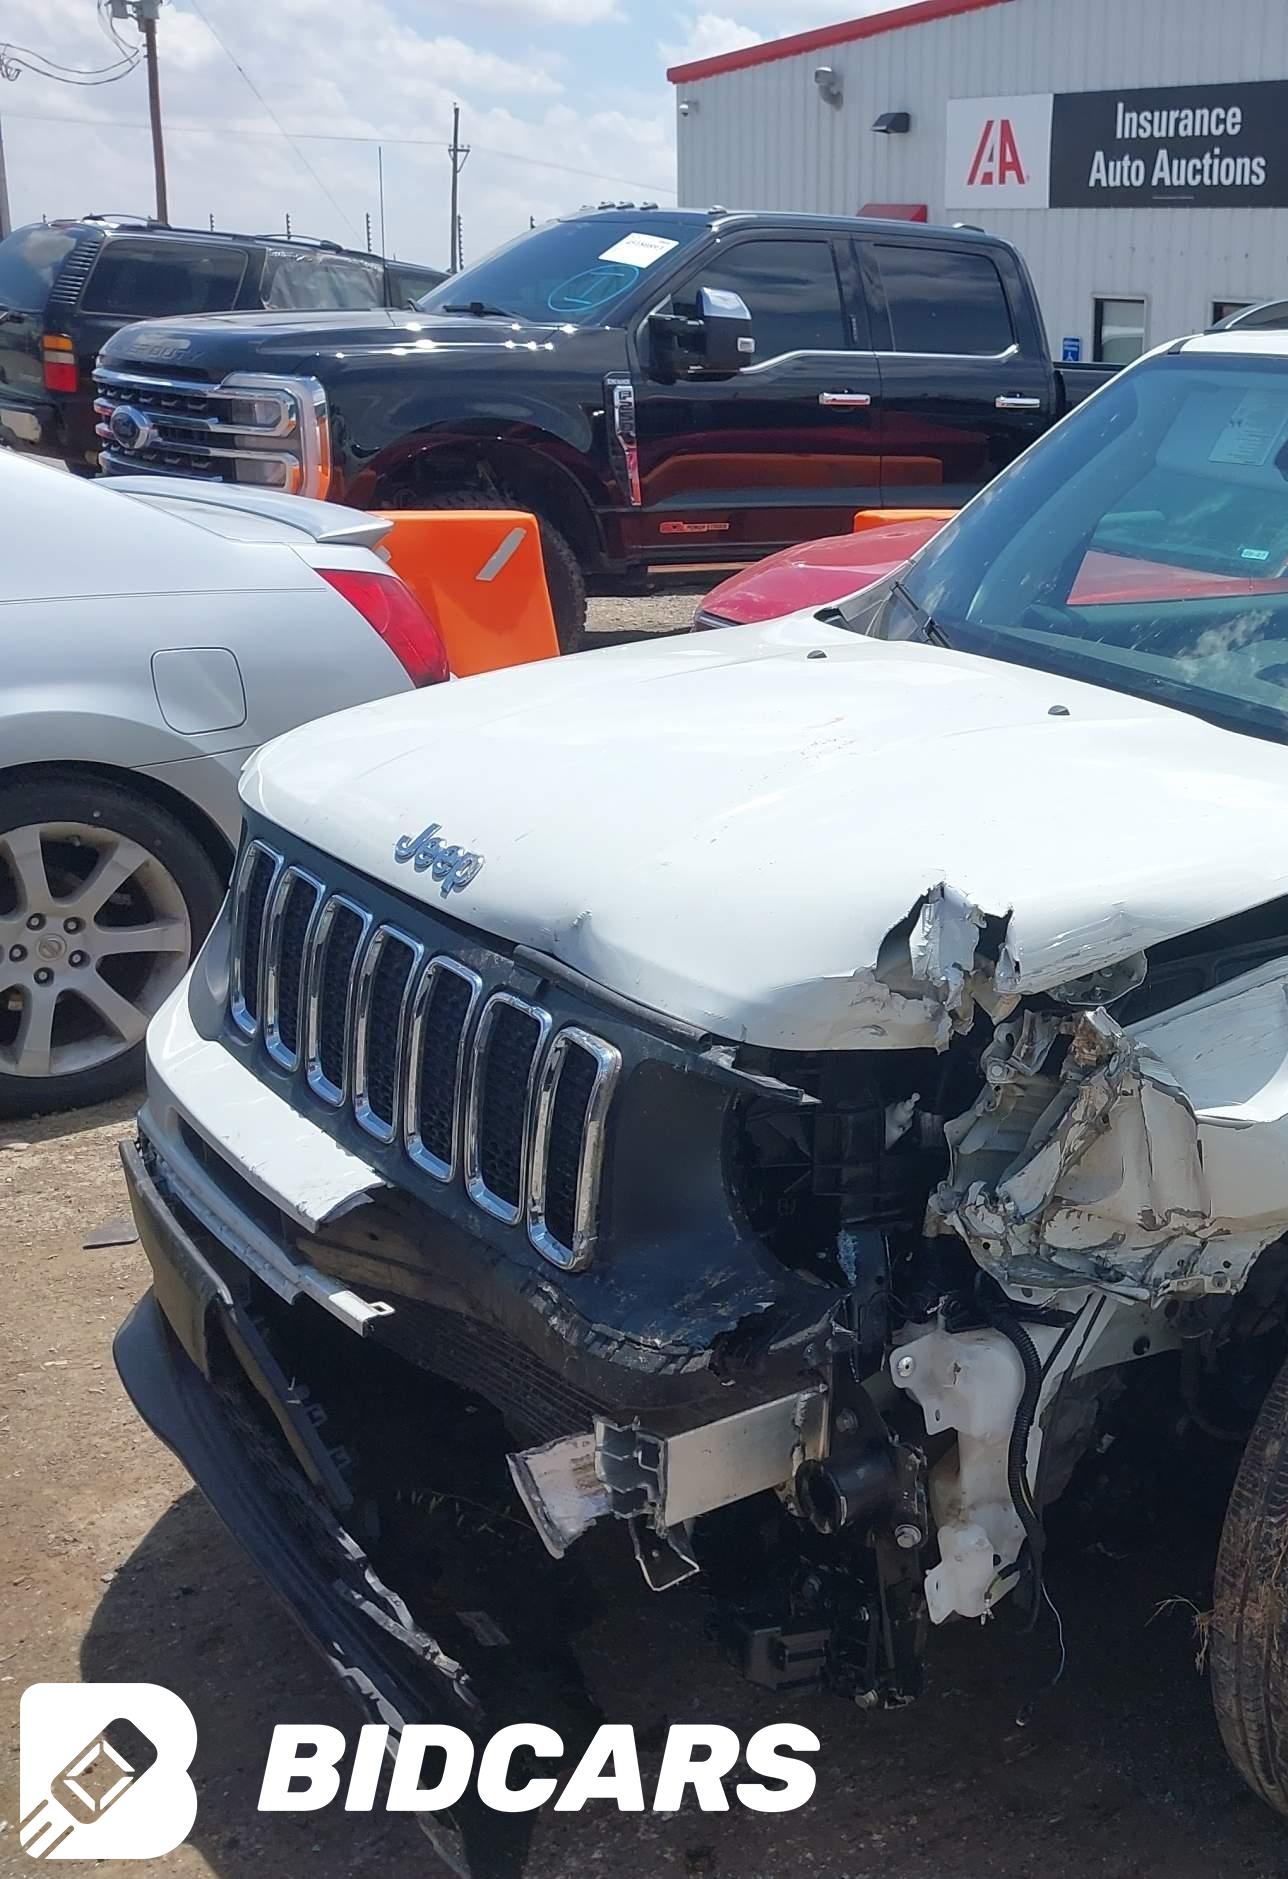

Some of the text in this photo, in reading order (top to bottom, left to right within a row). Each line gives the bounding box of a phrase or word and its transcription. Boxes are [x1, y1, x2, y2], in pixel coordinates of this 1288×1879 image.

[1115, 101, 1243, 139] Insurance
[1088, 147, 1266, 187] Auto Auctions
[394, 822, 485, 900] Jeep
